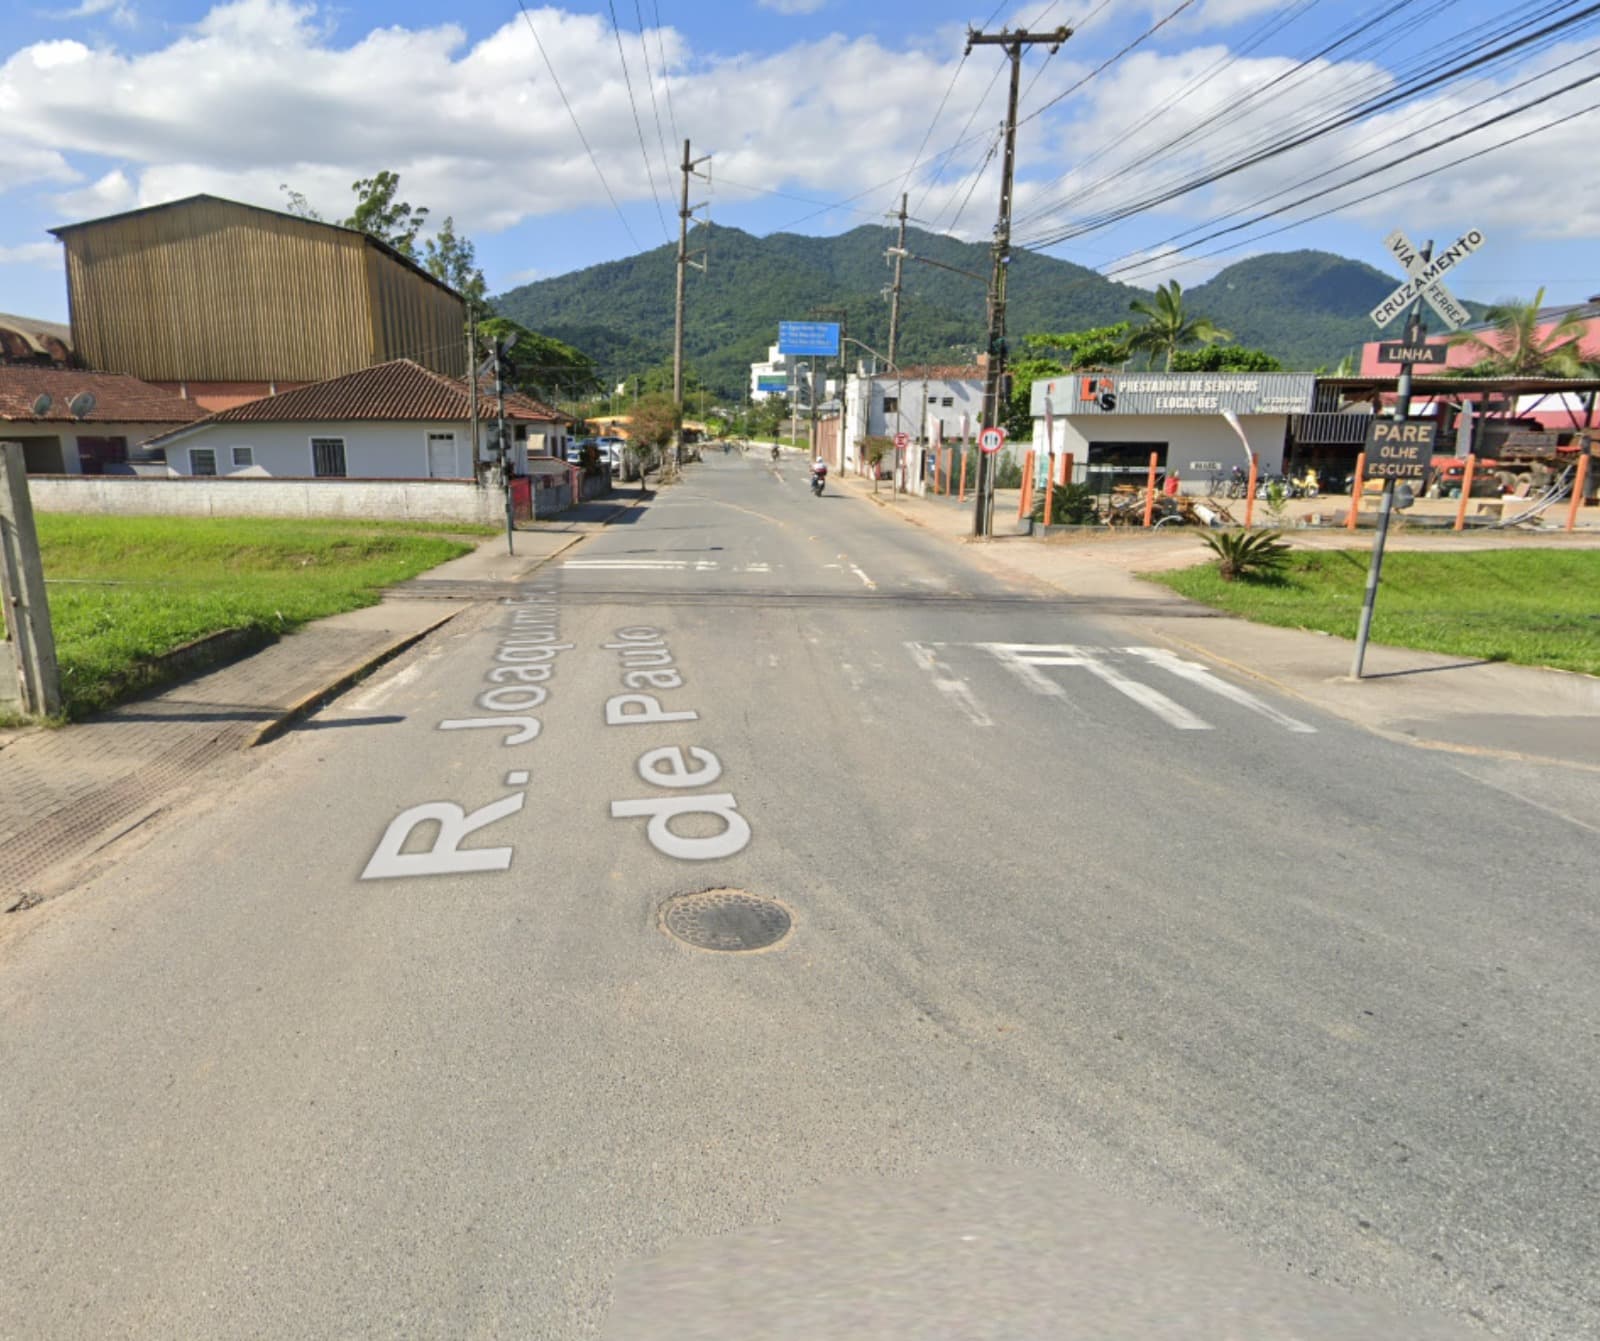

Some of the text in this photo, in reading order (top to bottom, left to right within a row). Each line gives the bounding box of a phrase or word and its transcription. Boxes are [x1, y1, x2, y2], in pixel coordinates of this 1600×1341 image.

[1393, 238, 1415, 268] VIA
[1375, 231, 1482, 323] CRUZAMENTO
[1389, 348, 1433, 361] LINHA
[1119, 380, 1187, 393] PRESTADORA
[1374, 424, 1432, 442] PARE
[1380, 446, 1419, 459] OLHE
[1368, 463, 1424, 476] ESCUTE
